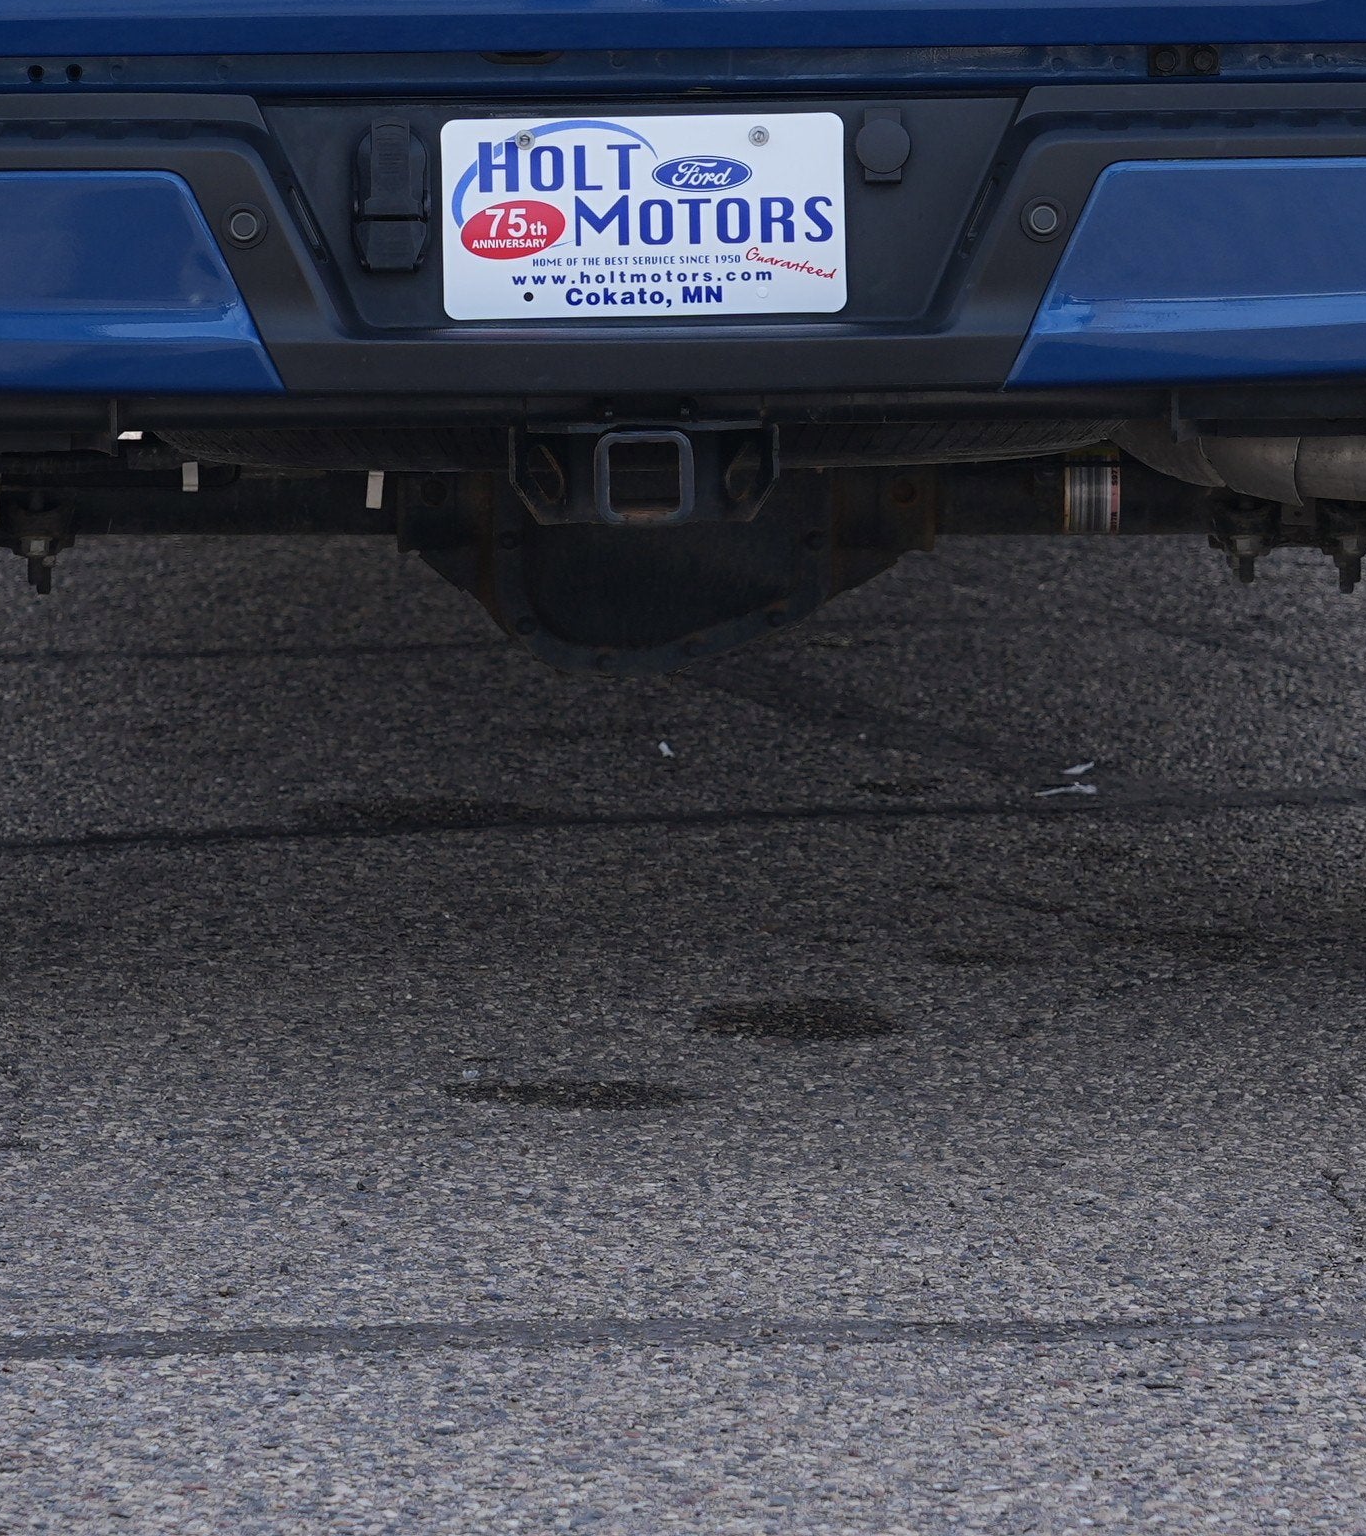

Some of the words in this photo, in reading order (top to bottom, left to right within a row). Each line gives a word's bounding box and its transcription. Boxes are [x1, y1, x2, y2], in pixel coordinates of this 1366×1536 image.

[478, 141, 641, 193] HOLT
[672, 160, 733, 186] Ford
[485, 208, 548, 238] 75th
[574, 195, 833, 247] MOTORS
[472, 238, 547, 249] ANNIVERSARY
[532, 257, 563, 267] HOME
[566, 257, 578, 267] OF
[583, 257, 602, 266] THE
[604, 256, 629, 266] BEST
[632, 255, 676, 265] SERVICE
[679, 255, 710, 265] SINCE
[714, 254, 741, 264] 1950
[745, 247, 837, 280] Guaranteed
[512, 269, 773, 286] www.holtmotors.com
[565, 286, 673, 308] Cokato,
[682, 285, 723, 304] MN
